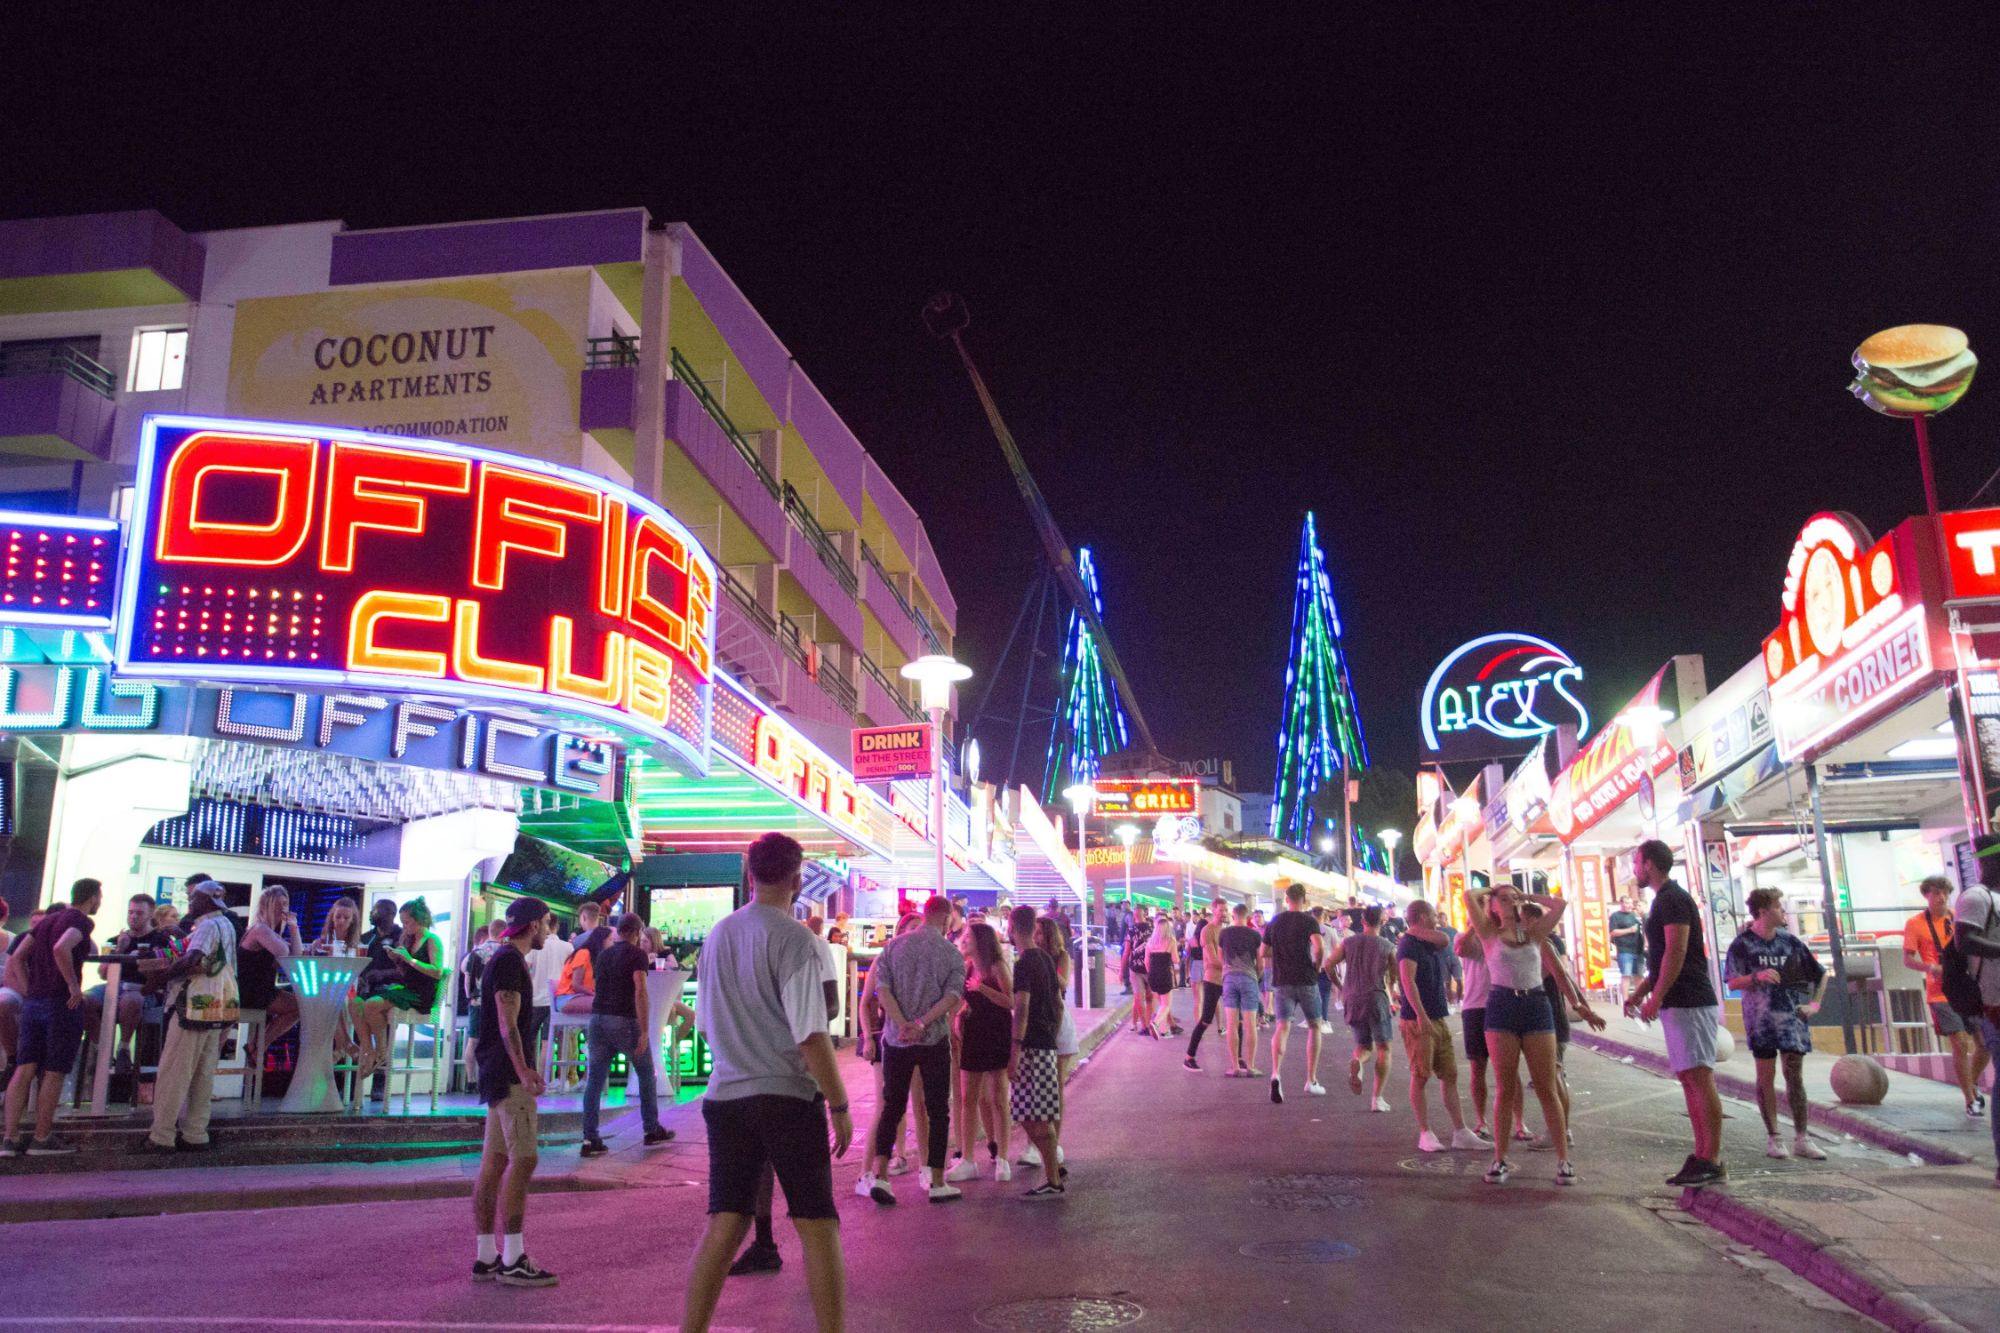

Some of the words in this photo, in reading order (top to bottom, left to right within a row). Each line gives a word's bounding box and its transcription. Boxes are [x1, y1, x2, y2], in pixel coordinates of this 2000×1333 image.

[309, 371, 492, 404] APARTMENTS
[314, 326, 495, 370] COCONUT
[155, 432, 713, 684] OFFICE
[347, 589, 672, 727] CLUB
[1834, 627, 1923, 712] CORNER
[214, 689, 614, 794] OFFICE
[757, 715, 874, 840] OFFICE
[855, 754, 870, 764] ON
[871, 753, 891, 763] THE
[893, 750, 929, 762] STREET
[861, 731, 920, 752] DRINK
[1134, 793, 1191, 809] GRILL
[1583, 902, 1607, 985] PIZZA
